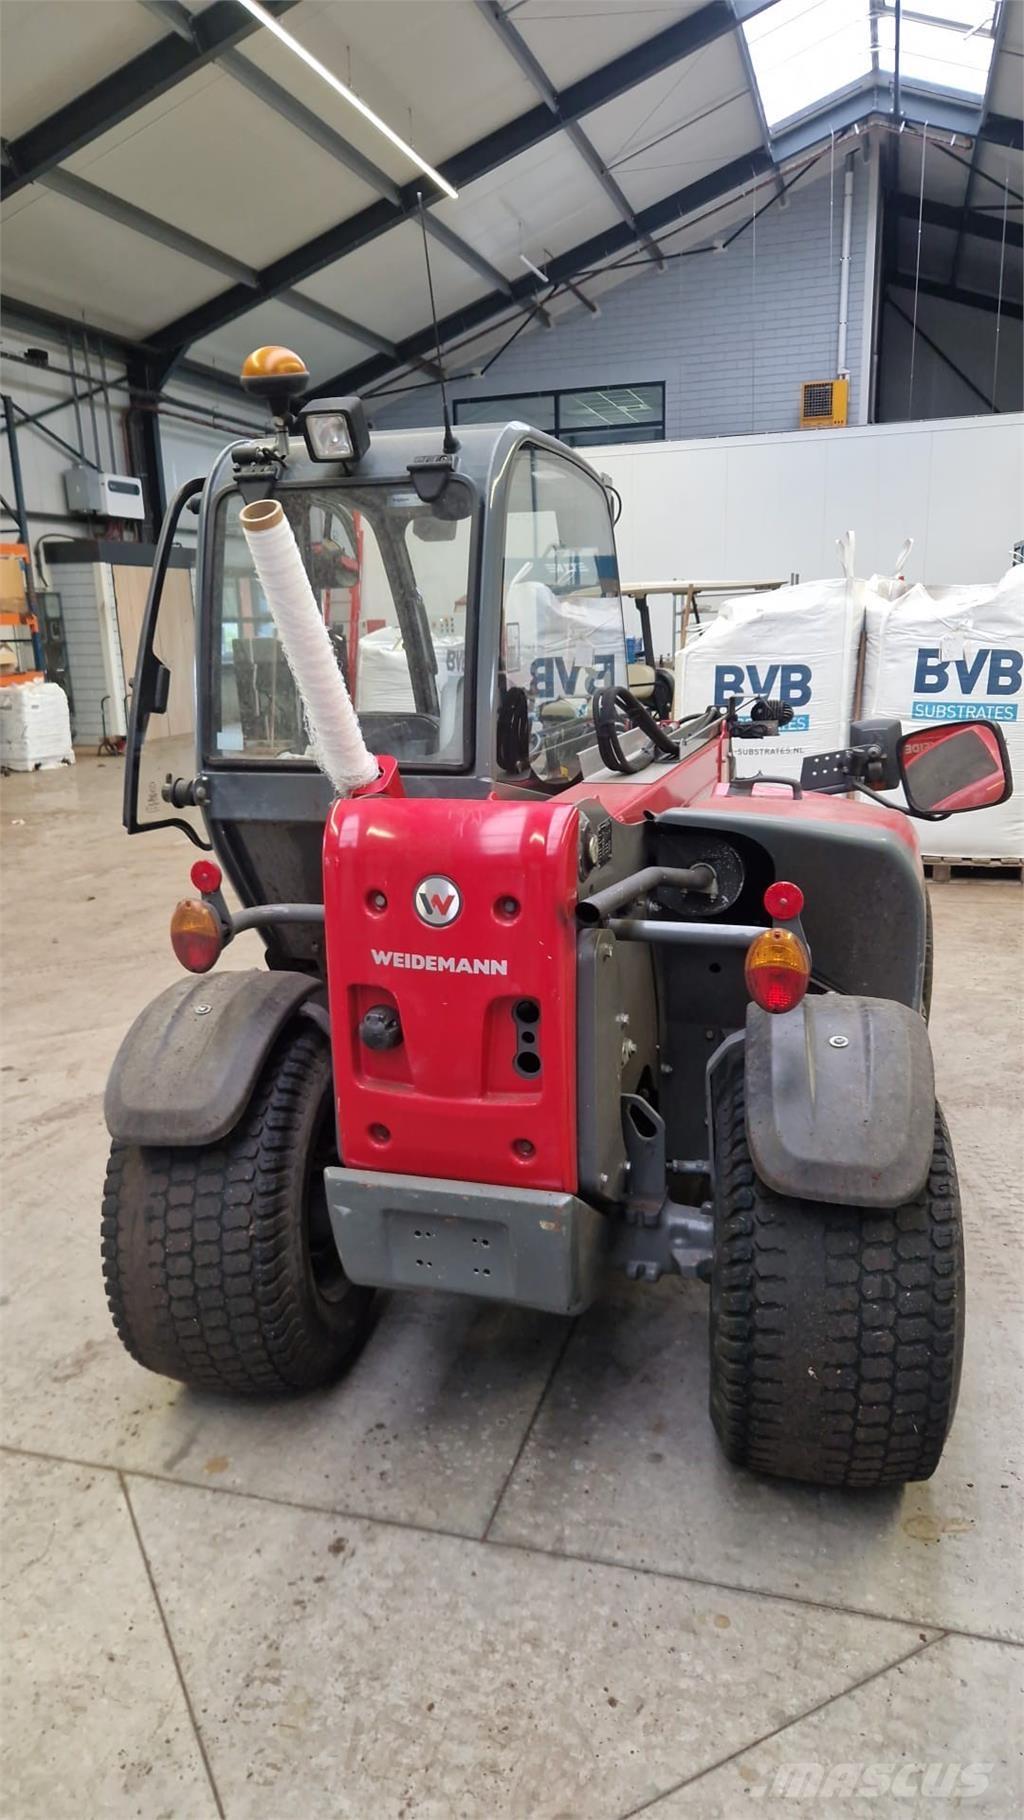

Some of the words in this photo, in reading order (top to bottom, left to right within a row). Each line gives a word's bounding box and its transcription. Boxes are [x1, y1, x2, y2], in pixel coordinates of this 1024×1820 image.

[446, 650, 465, 672] BV
[913, 648, 1024, 696] BVB
[713, 664, 813, 708] BVB
[914, 703, 1015, 722] SUBSTRATES
[371, 948, 508, 976] WEIDEMANN
